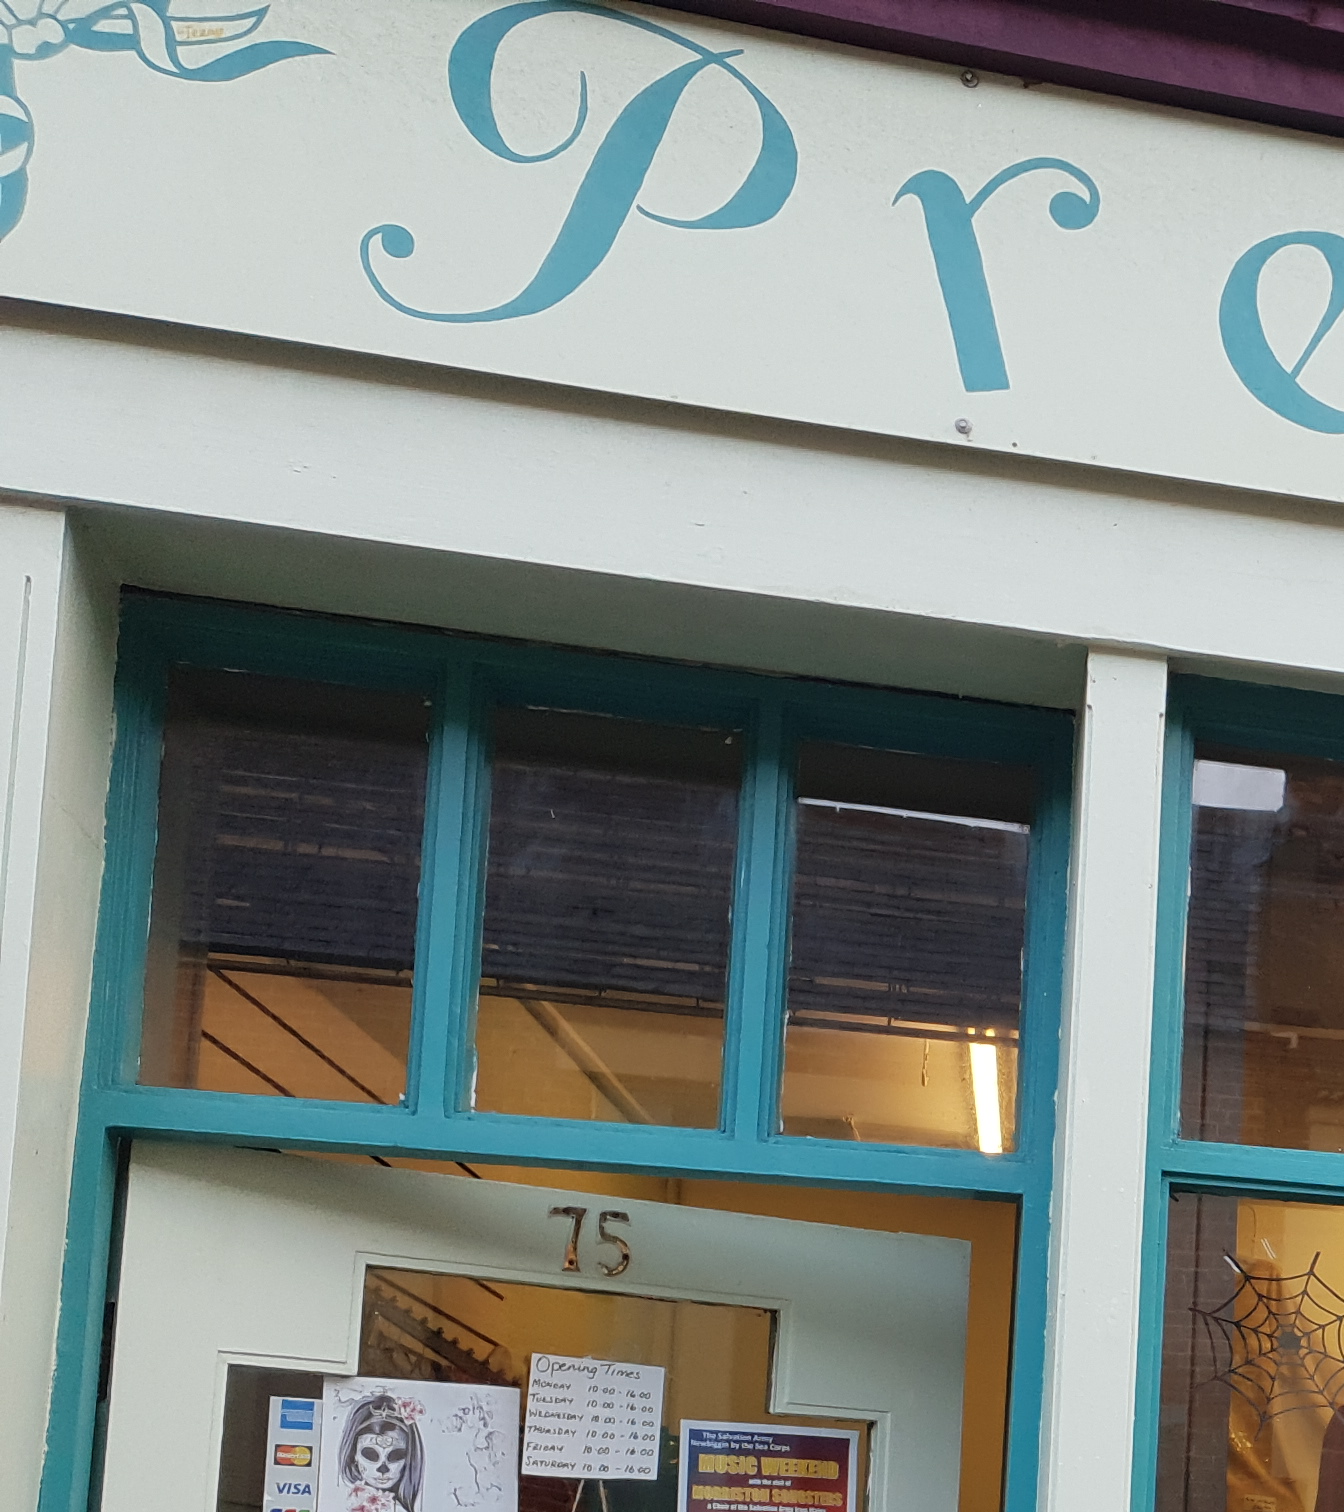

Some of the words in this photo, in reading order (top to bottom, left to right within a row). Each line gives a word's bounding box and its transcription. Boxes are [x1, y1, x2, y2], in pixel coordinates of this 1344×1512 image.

[548, 1206, 632, 1278] 75
[536, 1355, 599, 1380] Opening
[600, 1363, 641, 1380] Times
[532, 1379, 572, 1391] MONDAY
[529, 1393, 574, 1405] TUESDAY
[529, 1409, 584, 1422] WEDNESDAY
[527, 1425, 577, 1438] THURSDAY
[703, 1432, 716, 1440] The
[525, 1441, 565, 1454] FRIDAY
[525, 1455, 577, 1471] SATURDAY
[698, 1453, 758, 1475] MUSIC
[760, 1456, 840, 1480] WEEKEND
[275, 1482, 312, 1496] VISA
